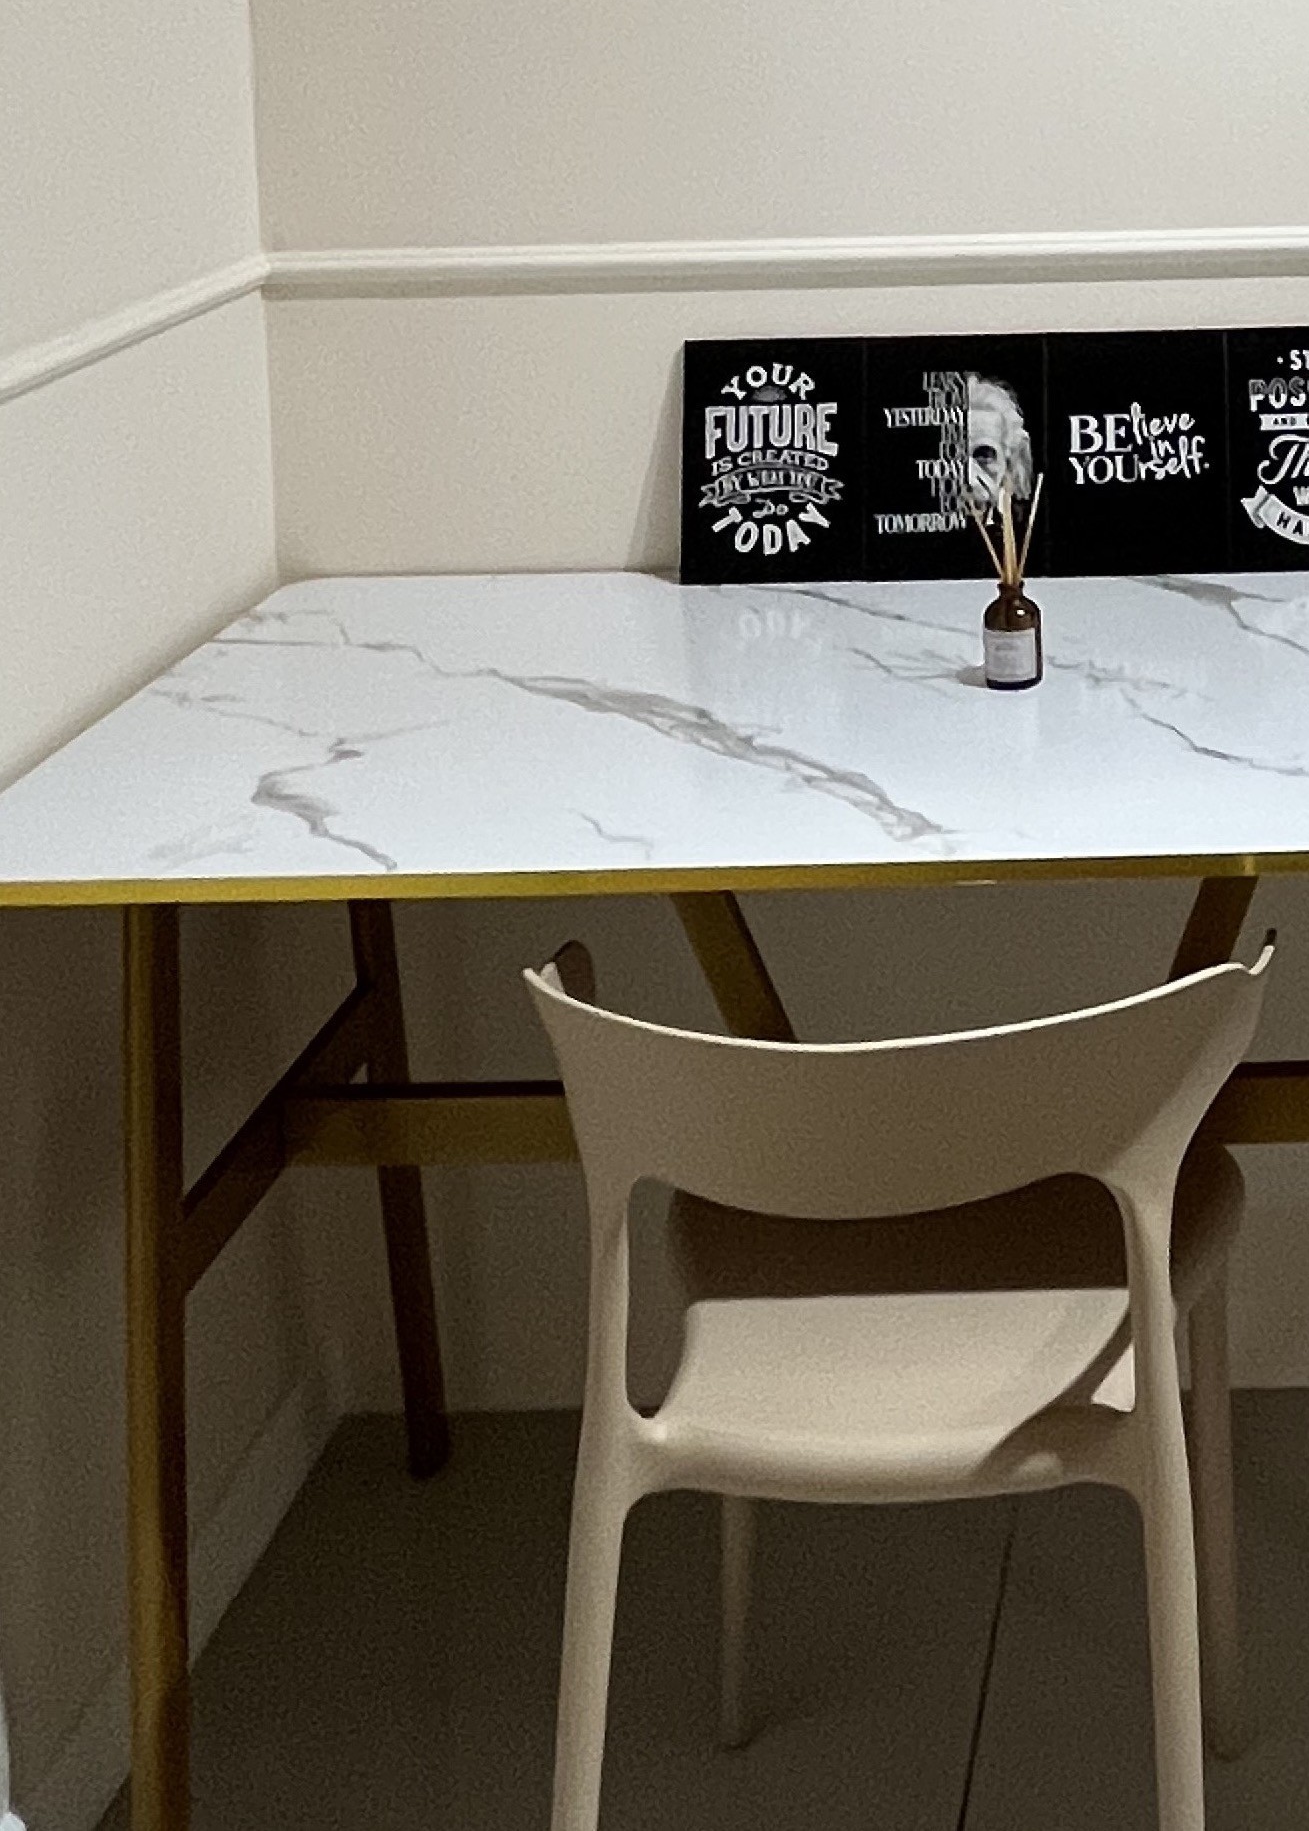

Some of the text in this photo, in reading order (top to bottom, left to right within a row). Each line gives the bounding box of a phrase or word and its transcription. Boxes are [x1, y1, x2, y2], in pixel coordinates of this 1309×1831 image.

[721, 362, 815, 400] YOUR
[705, 402, 838, 459] FUTURE
[883, 407, 965, 428] YESTERDAY
[711, 449, 828, 476] IS CREATED
[1149, 435, 1175, 464] in
[916, 459, 965, 479] TODAY
[712, 502, 831, 556] TODAY
[874, 513, 967, 534] TOMORROW
